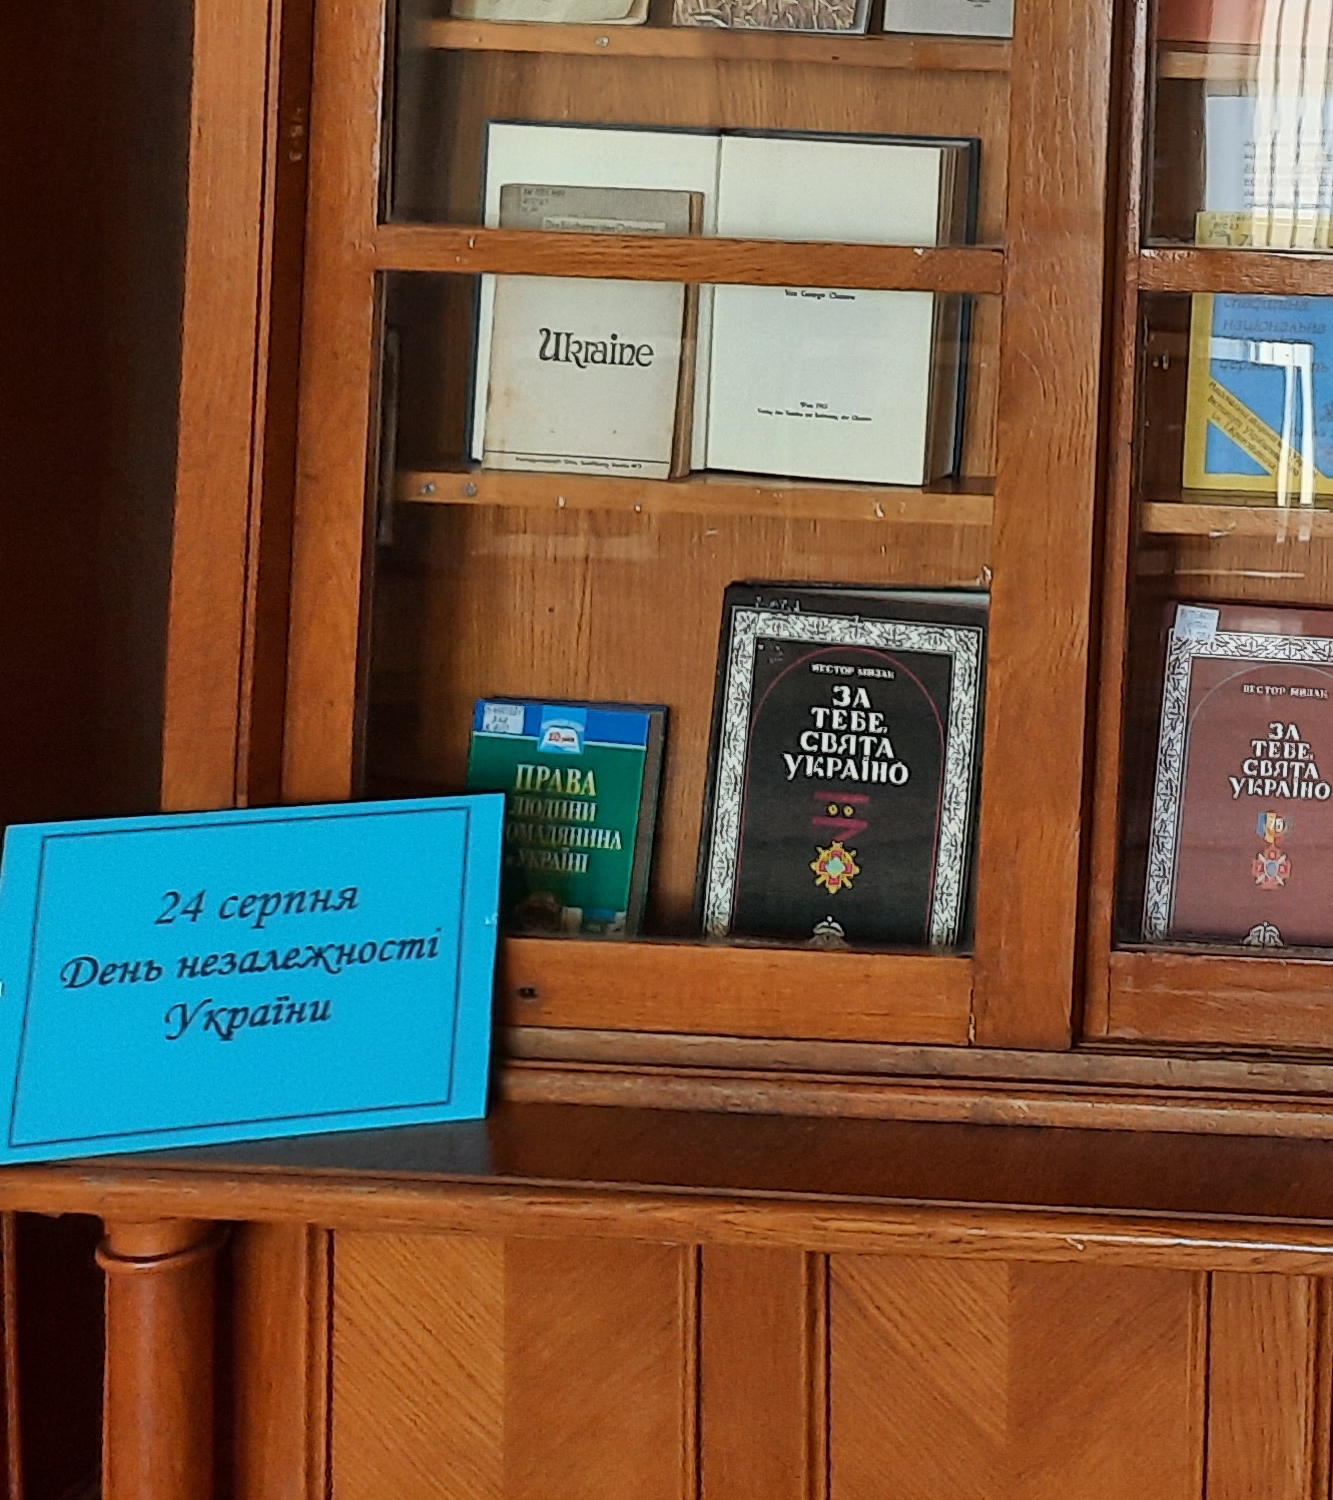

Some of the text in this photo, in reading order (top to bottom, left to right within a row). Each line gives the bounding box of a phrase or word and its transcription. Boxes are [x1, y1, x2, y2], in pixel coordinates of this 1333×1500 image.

[539, 327, 654, 368] Ukraine
[832, 685, 871, 709] ЗА
[810, 706, 889, 734] ТЕБЕ,
[1268, 722, 1300, 741] ЗА
[800, 730, 895, 760] СВЯТА
[515, 763, 597, 797] ПРАВА
[782, 752, 910, 786] УКРАЇНО
[1242, 758, 1320, 780] СВЯТА
[1228, 775, 1332, 801] УКРАЇНО
[154, 886, 359, 930] 24 серпня
[60, 927, 441, 990] День незалежності
[164, 997, 332, 1042] України
